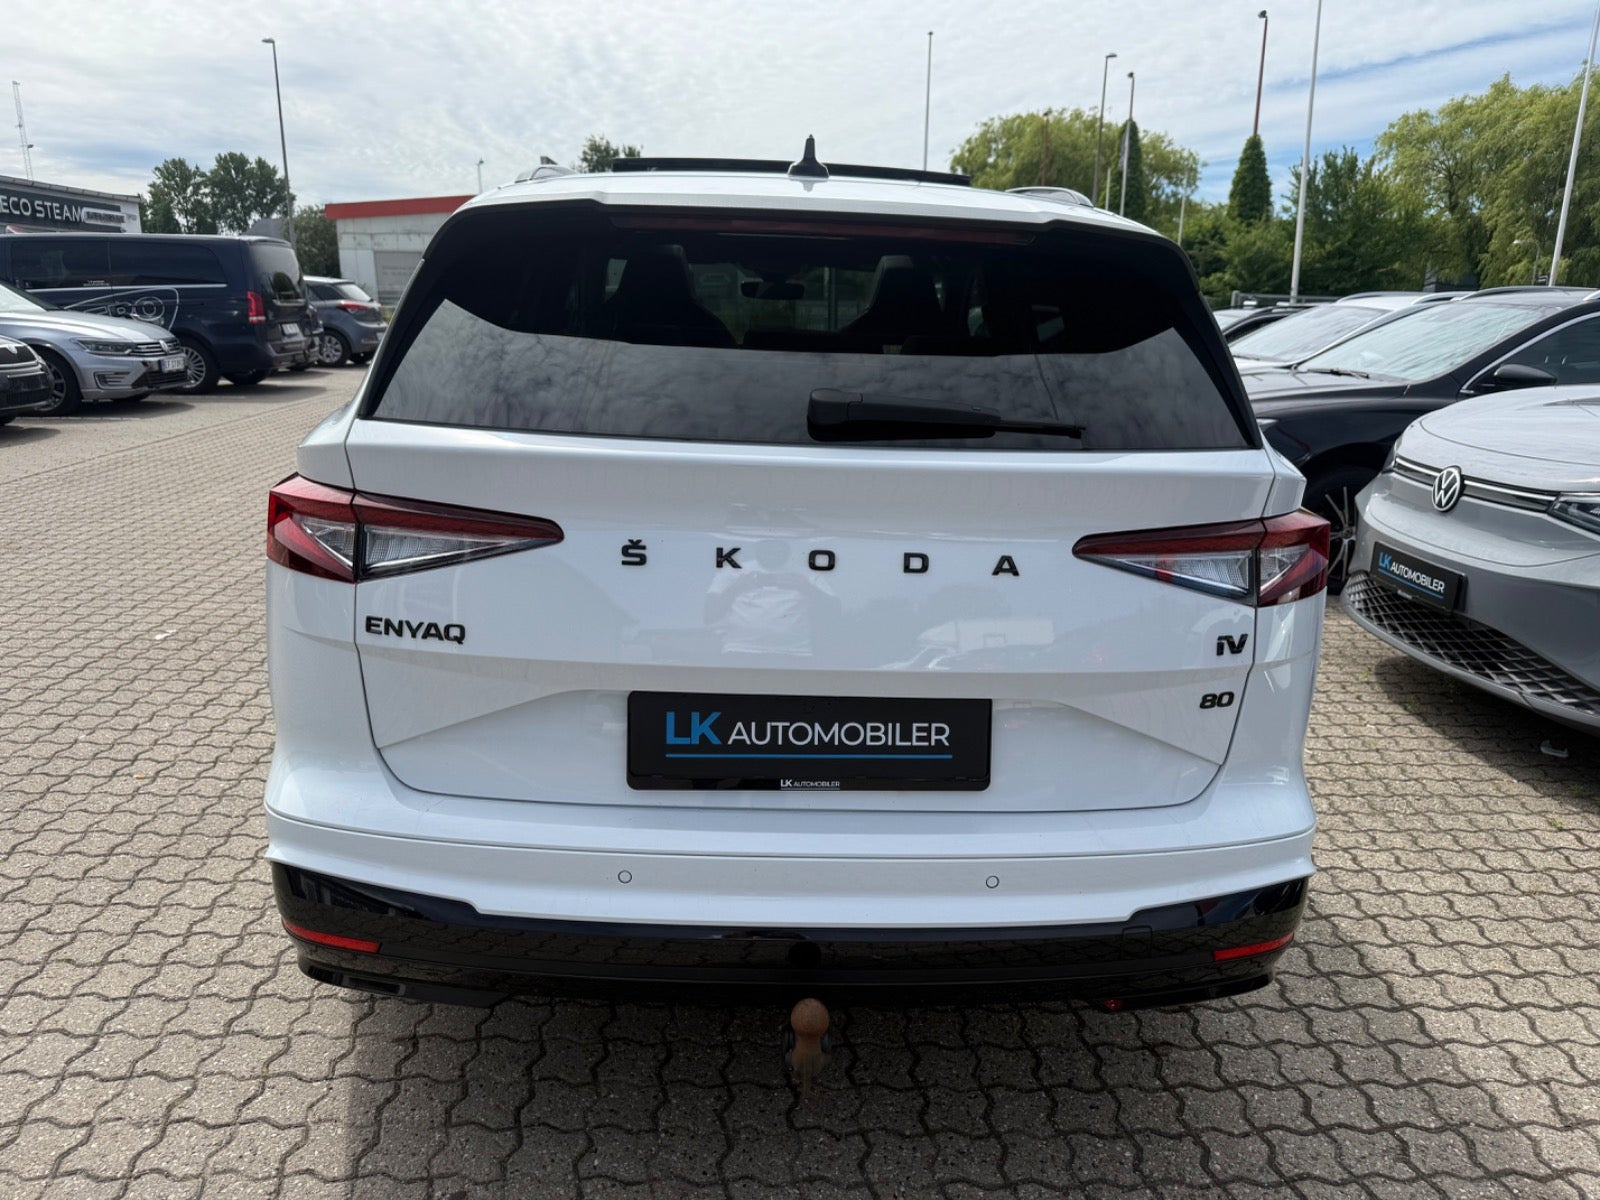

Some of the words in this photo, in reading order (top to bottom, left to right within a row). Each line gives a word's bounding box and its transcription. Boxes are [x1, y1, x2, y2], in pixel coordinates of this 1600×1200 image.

[0, 194, 32, 217] ECO
[34, 199, 86, 222] STEAM
[621, 539, 1020, 577] ŠKODA
[1378, 551, 1392, 570] LK
[1390, 561, 1446, 593] AUTOMOBILER
[365, 616, 466, 645] ENYAQ
[1199, 692, 1235, 709] 80
[665, 711, 722, 746] LK
[727, 721, 951, 748] AUTOMOBILER
[780, 779, 793, 788] LK
[793, 780, 841, 788] AUTOMOBILER
